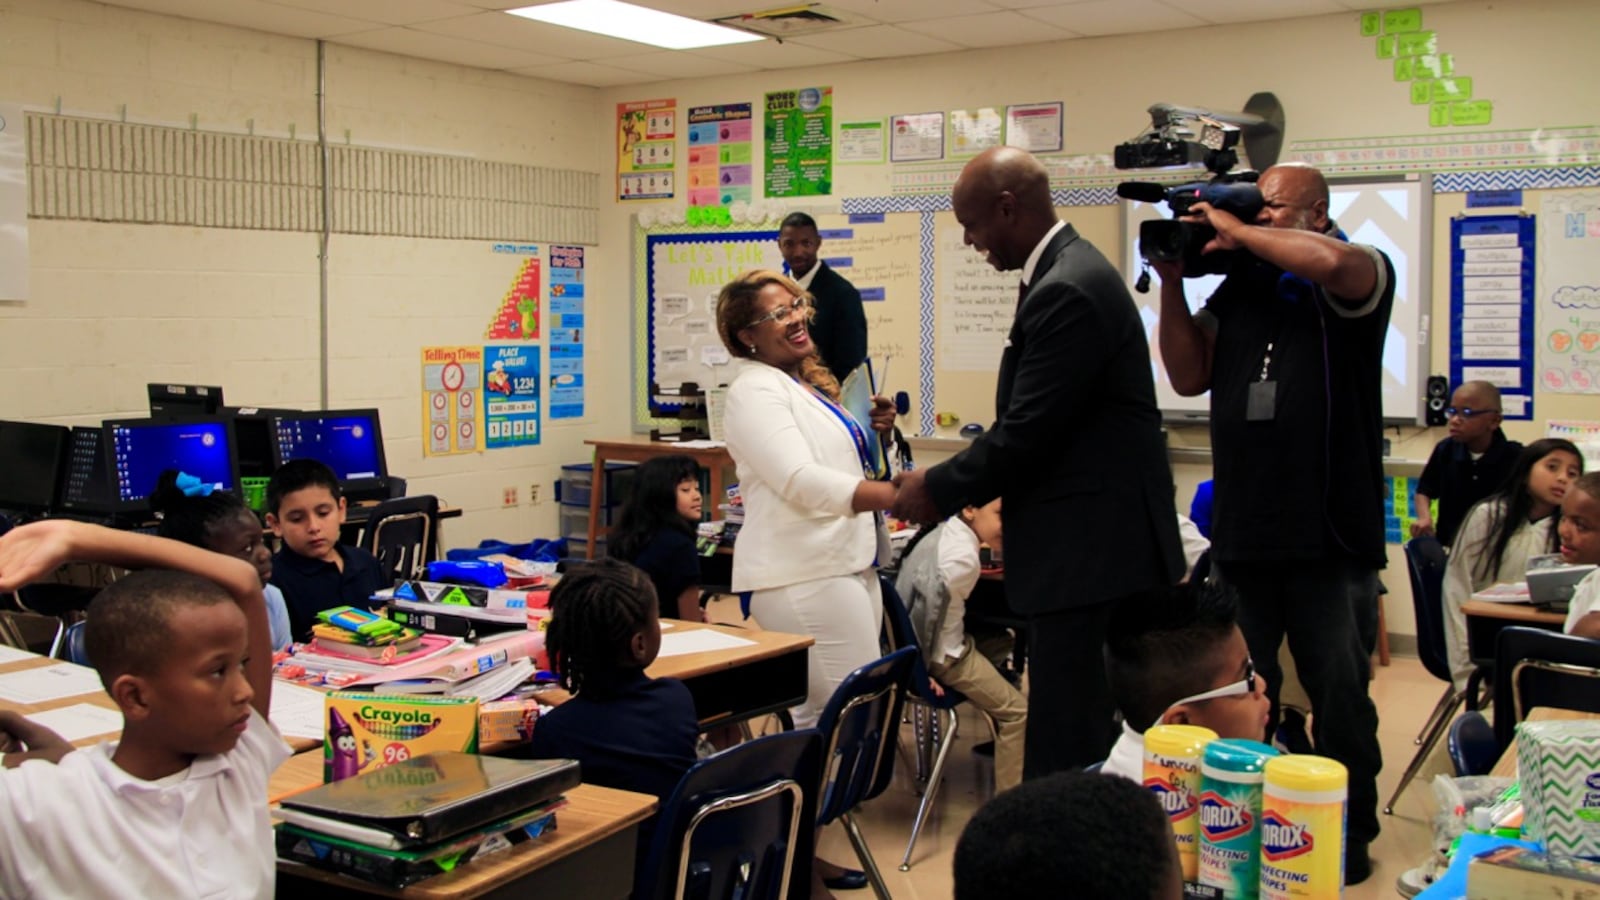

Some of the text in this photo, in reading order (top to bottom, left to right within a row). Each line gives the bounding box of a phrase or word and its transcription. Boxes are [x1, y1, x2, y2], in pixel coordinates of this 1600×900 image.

[767, 92, 796, 101] WORD
[767, 101, 795, 110] CLUES
[668, 243, 763, 265] Let's Talk
[424, 348, 481, 362] Telling Time
[499, 348, 519, 357] PLACE
[513, 377, 535, 389] 1,234
[360, 704, 431, 725] Crayola
[385, 748, 408, 764] 96
